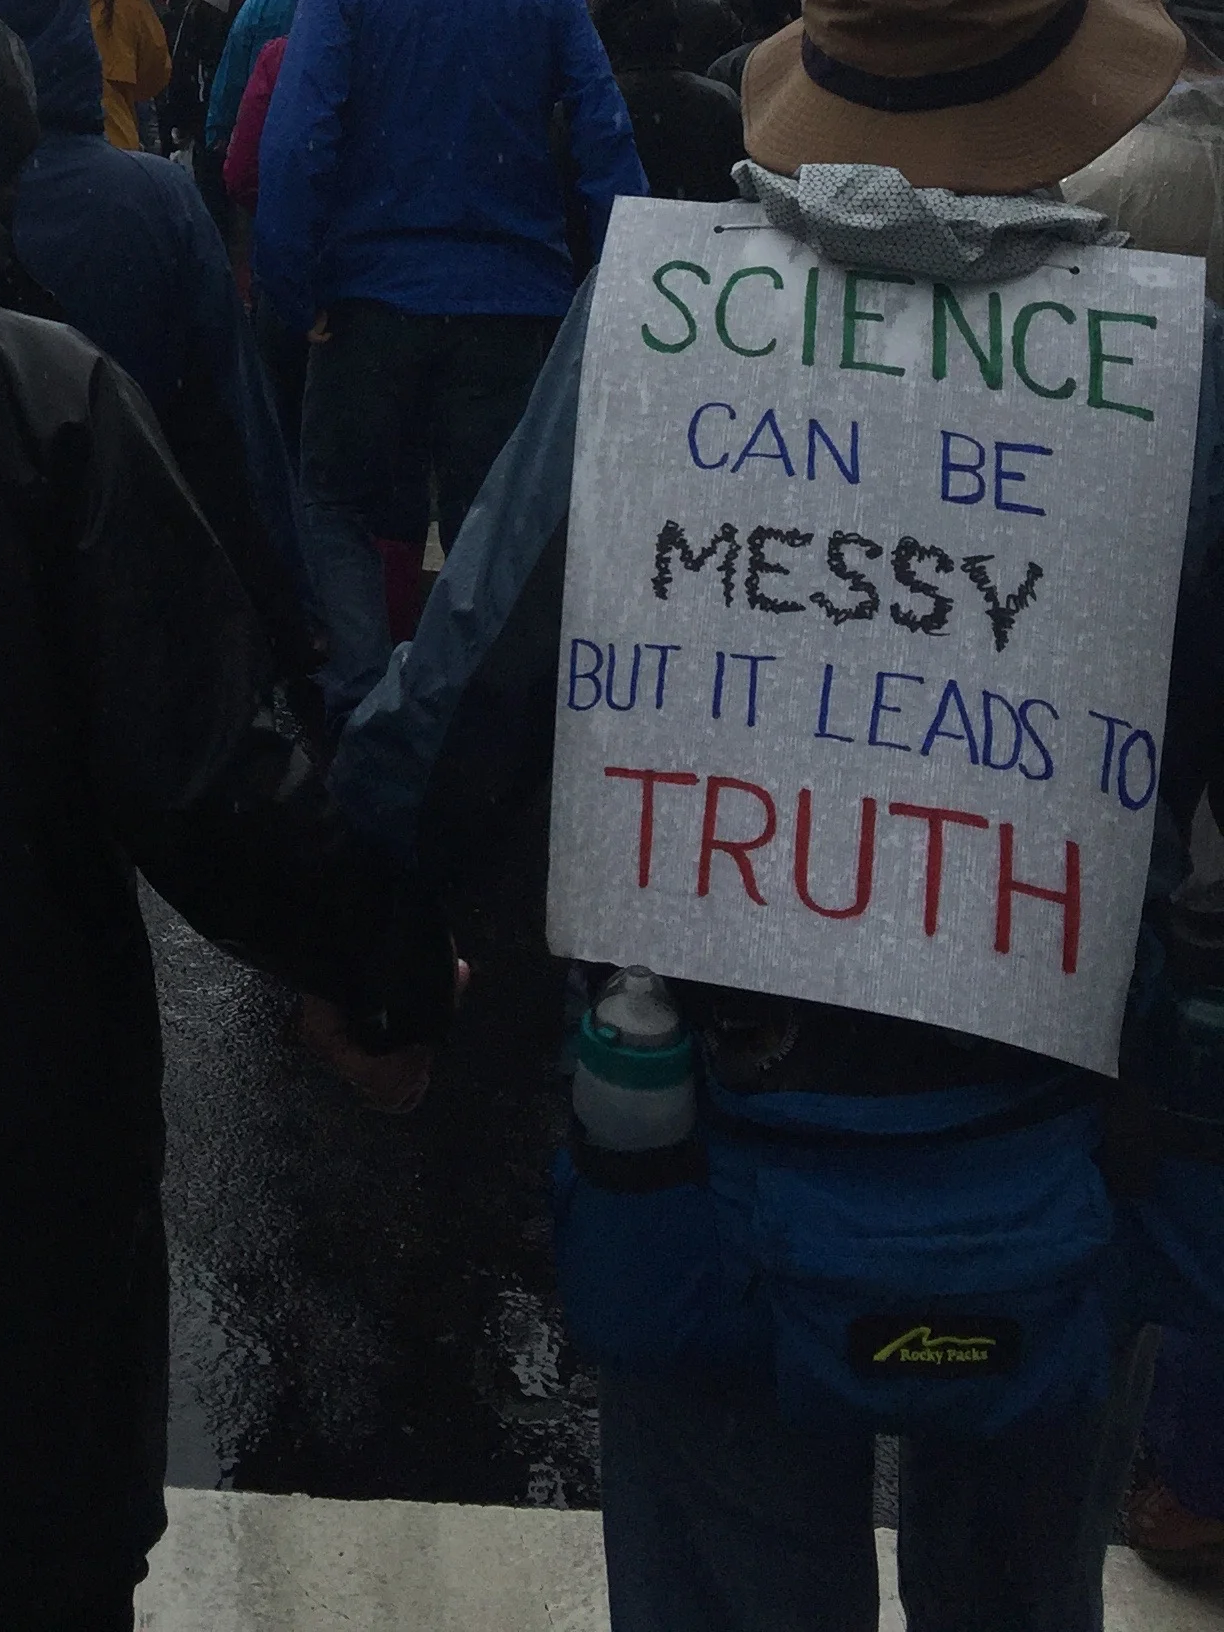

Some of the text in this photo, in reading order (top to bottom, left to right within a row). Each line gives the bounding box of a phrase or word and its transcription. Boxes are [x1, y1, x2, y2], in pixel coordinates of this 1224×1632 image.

[641, 260, 1157, 421] SCIENCE
[687, 401, 1054, 516] CAN BE
[652, 520, 1044, 652] MESSY
[567, 639, 1157, 810] BUT IT LEADS TO
[604, 766, 1081, 974] TRUTH
[900, 1347, 989, 1365] Rocky Packs
